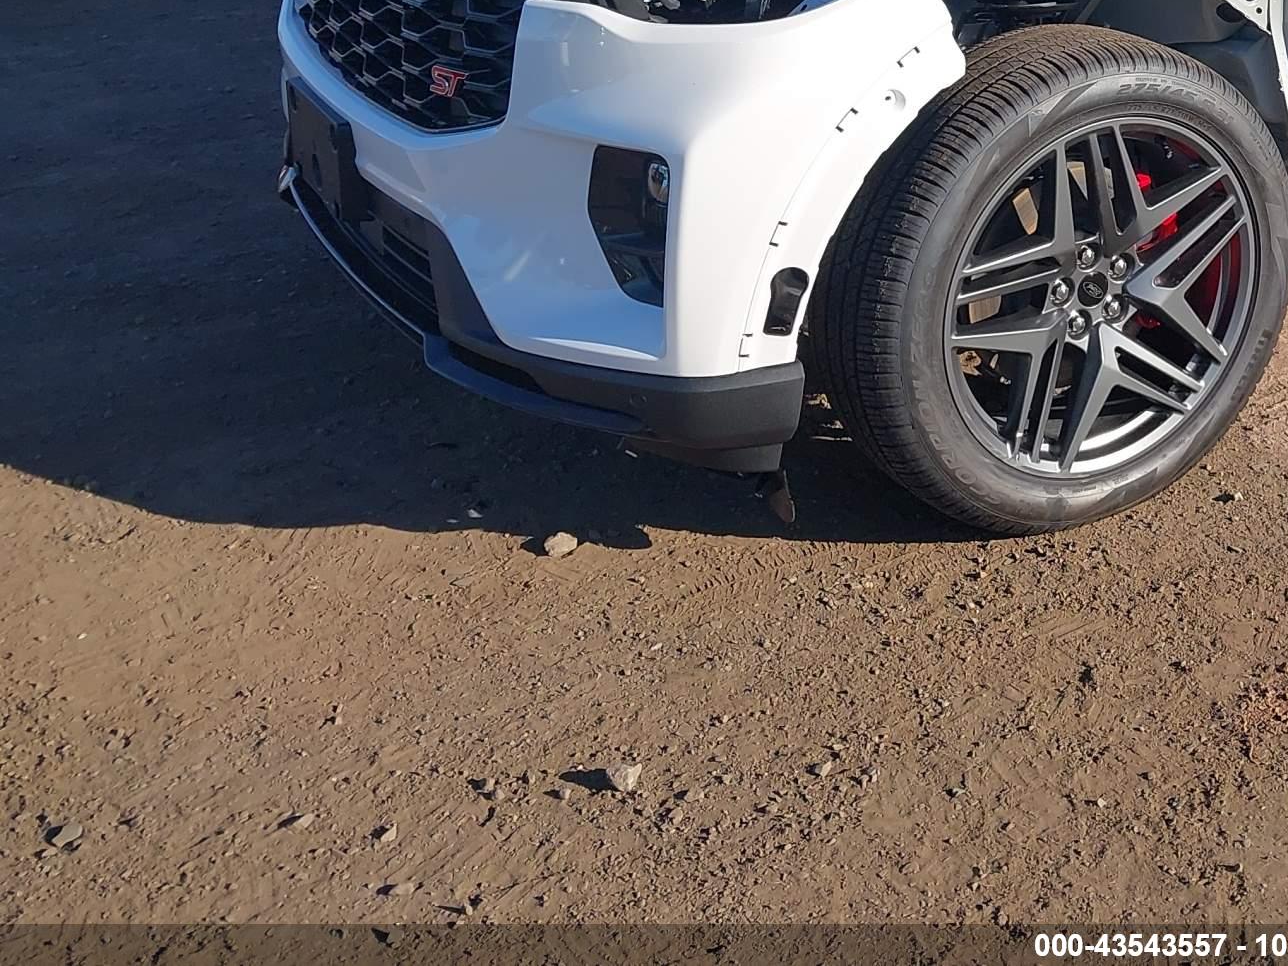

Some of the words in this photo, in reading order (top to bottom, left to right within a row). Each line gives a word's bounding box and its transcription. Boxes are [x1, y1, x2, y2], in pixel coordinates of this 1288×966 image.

[429, 65, 469, 97] ST
[1116, 82, 1200, 102] 275/45
[911, 378, 1002, 506] SCORPION
